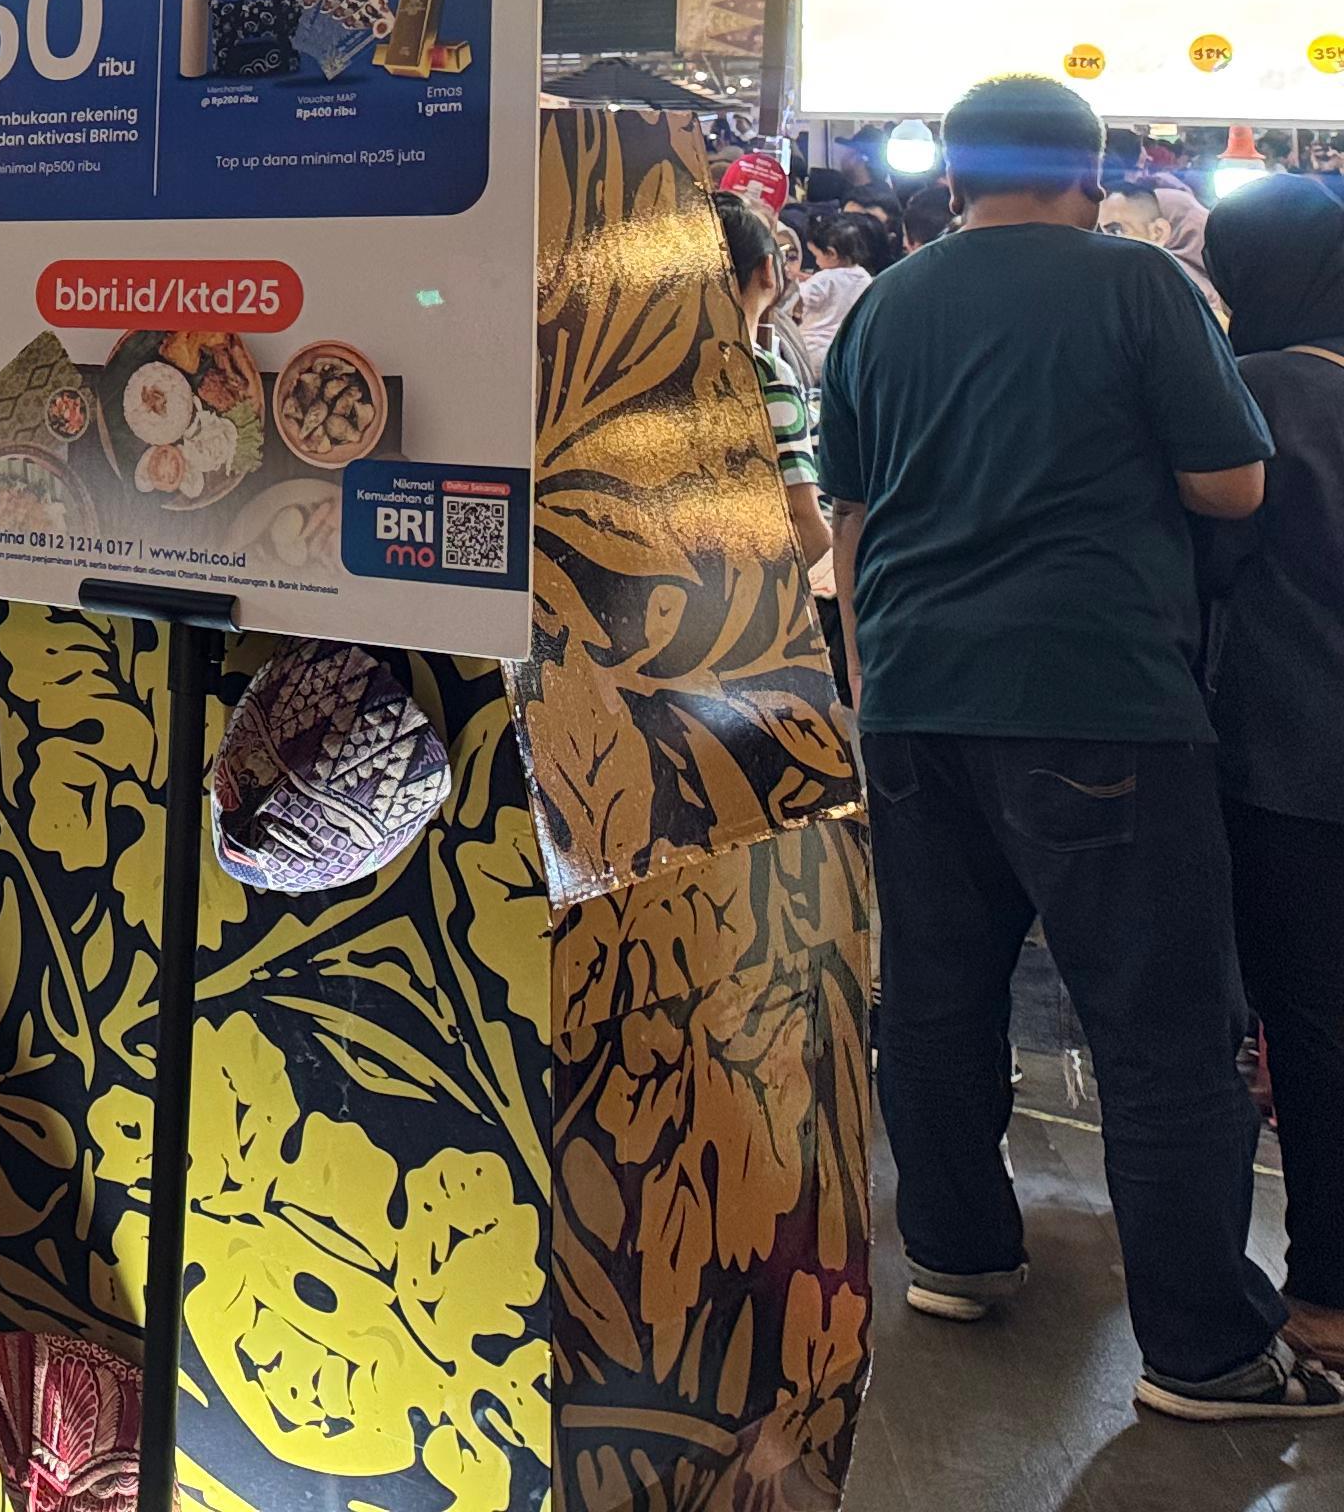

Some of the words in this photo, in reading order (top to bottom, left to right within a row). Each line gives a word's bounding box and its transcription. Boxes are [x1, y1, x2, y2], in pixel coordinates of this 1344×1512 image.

[98, 57, 135, 77] ribu
[240, 94, 259, 103] ribu
[297, 94, 334, 104] Voucher
[427, 87, 462, 98] Emas
[71, 106, 138, 125] rekening
[296, 107, 331, 120] Rp400
[334, 106, 357, 117] ribu
[417, 103, 423, 114] 1
[425, 101, 462, 116] gram
[28, 128, 86, 145] aktivasi
[90, 128, 138, 143] BRImo
[39, 160, 75, 176] Rp500
[78, 160, 101, 172] ribu
[216, 155, 239, 171] Top
[242, 156, 259, 170] up
[262, 152, 297, 166] dana
[301, 151, 356, 166] minimal
[360, 149, 394, 167] Rp25
[397, 149, 425, 166] juta
[55, 278, 280, 315] bbri.id/ktd25
[393, 478, 434, 491] Nikmati
[357, 490, 421, 504] Kemudahan
[424, 494, 434, 505] di
[376, 507, 434, 544] BRI
[30, 532, 64, 549] 0812
[69, 536, 102, 554] 1214
[107, 539, 133, 556] 017
[149, 548, 246, 567] www.bri.co.id
[386, 544, 435, 568] mo
